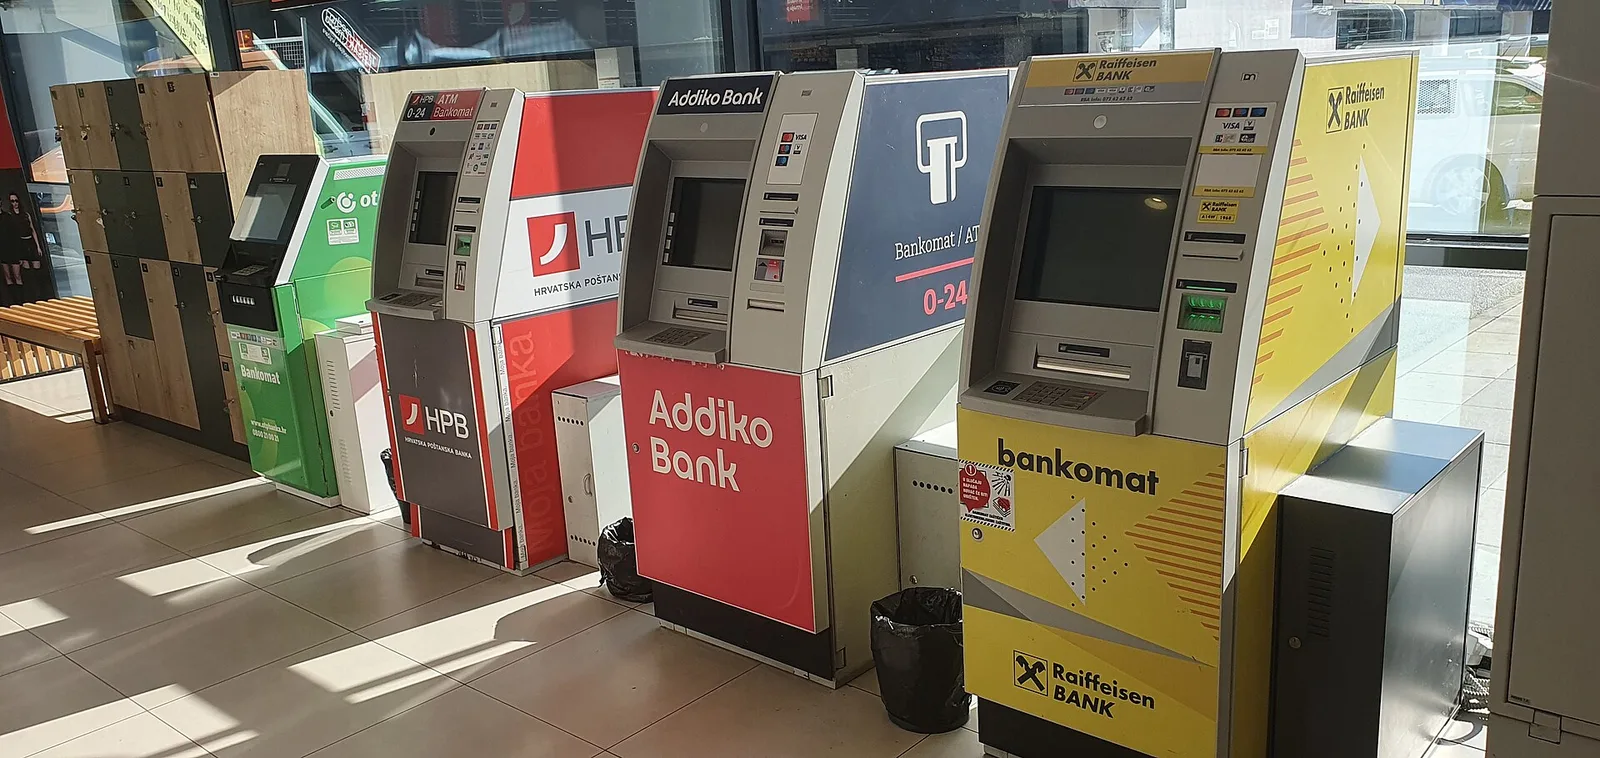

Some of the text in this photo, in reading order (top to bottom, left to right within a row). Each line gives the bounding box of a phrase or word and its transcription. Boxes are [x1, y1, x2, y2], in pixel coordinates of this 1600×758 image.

[1098, 58, 1157, 69] Raiffeisen
[1096, 70, 1132, 81] BANK
[420, 94, 458, 104] HPB ATM
[668, 87, 764, 106] Addiko Bank
[1345, 82, 1385, 105] Raiffeisen
[406, 106, 474, 118] 0-24 Bankomat
[1344, 108, 1370, 130] BANK
[360, 190, 380, 208] ot
[895, 231, 956, 260] Bankomat
[958, 225, 963, 247] /
[534, 273, 621, 297] HRVATSKA POŠTAN
[923, 280, 968, 315] 0-24
[240, 364, 280, 385] Bankomat
[509, 331, 544, 451] banka
[424, 406, 469, 439] HPB
[649, 389, 773, 448] Addiko
[404, 436, 472, 459] HRVATSKA POŠTANSKA BANKA
[650, 436, 740, 492] Bank
[997, 437, 1160, 496] bankomat
[1052, 662, 1155, 710] Raiffeisen
[1054, 684, 1116, 719] BANK
